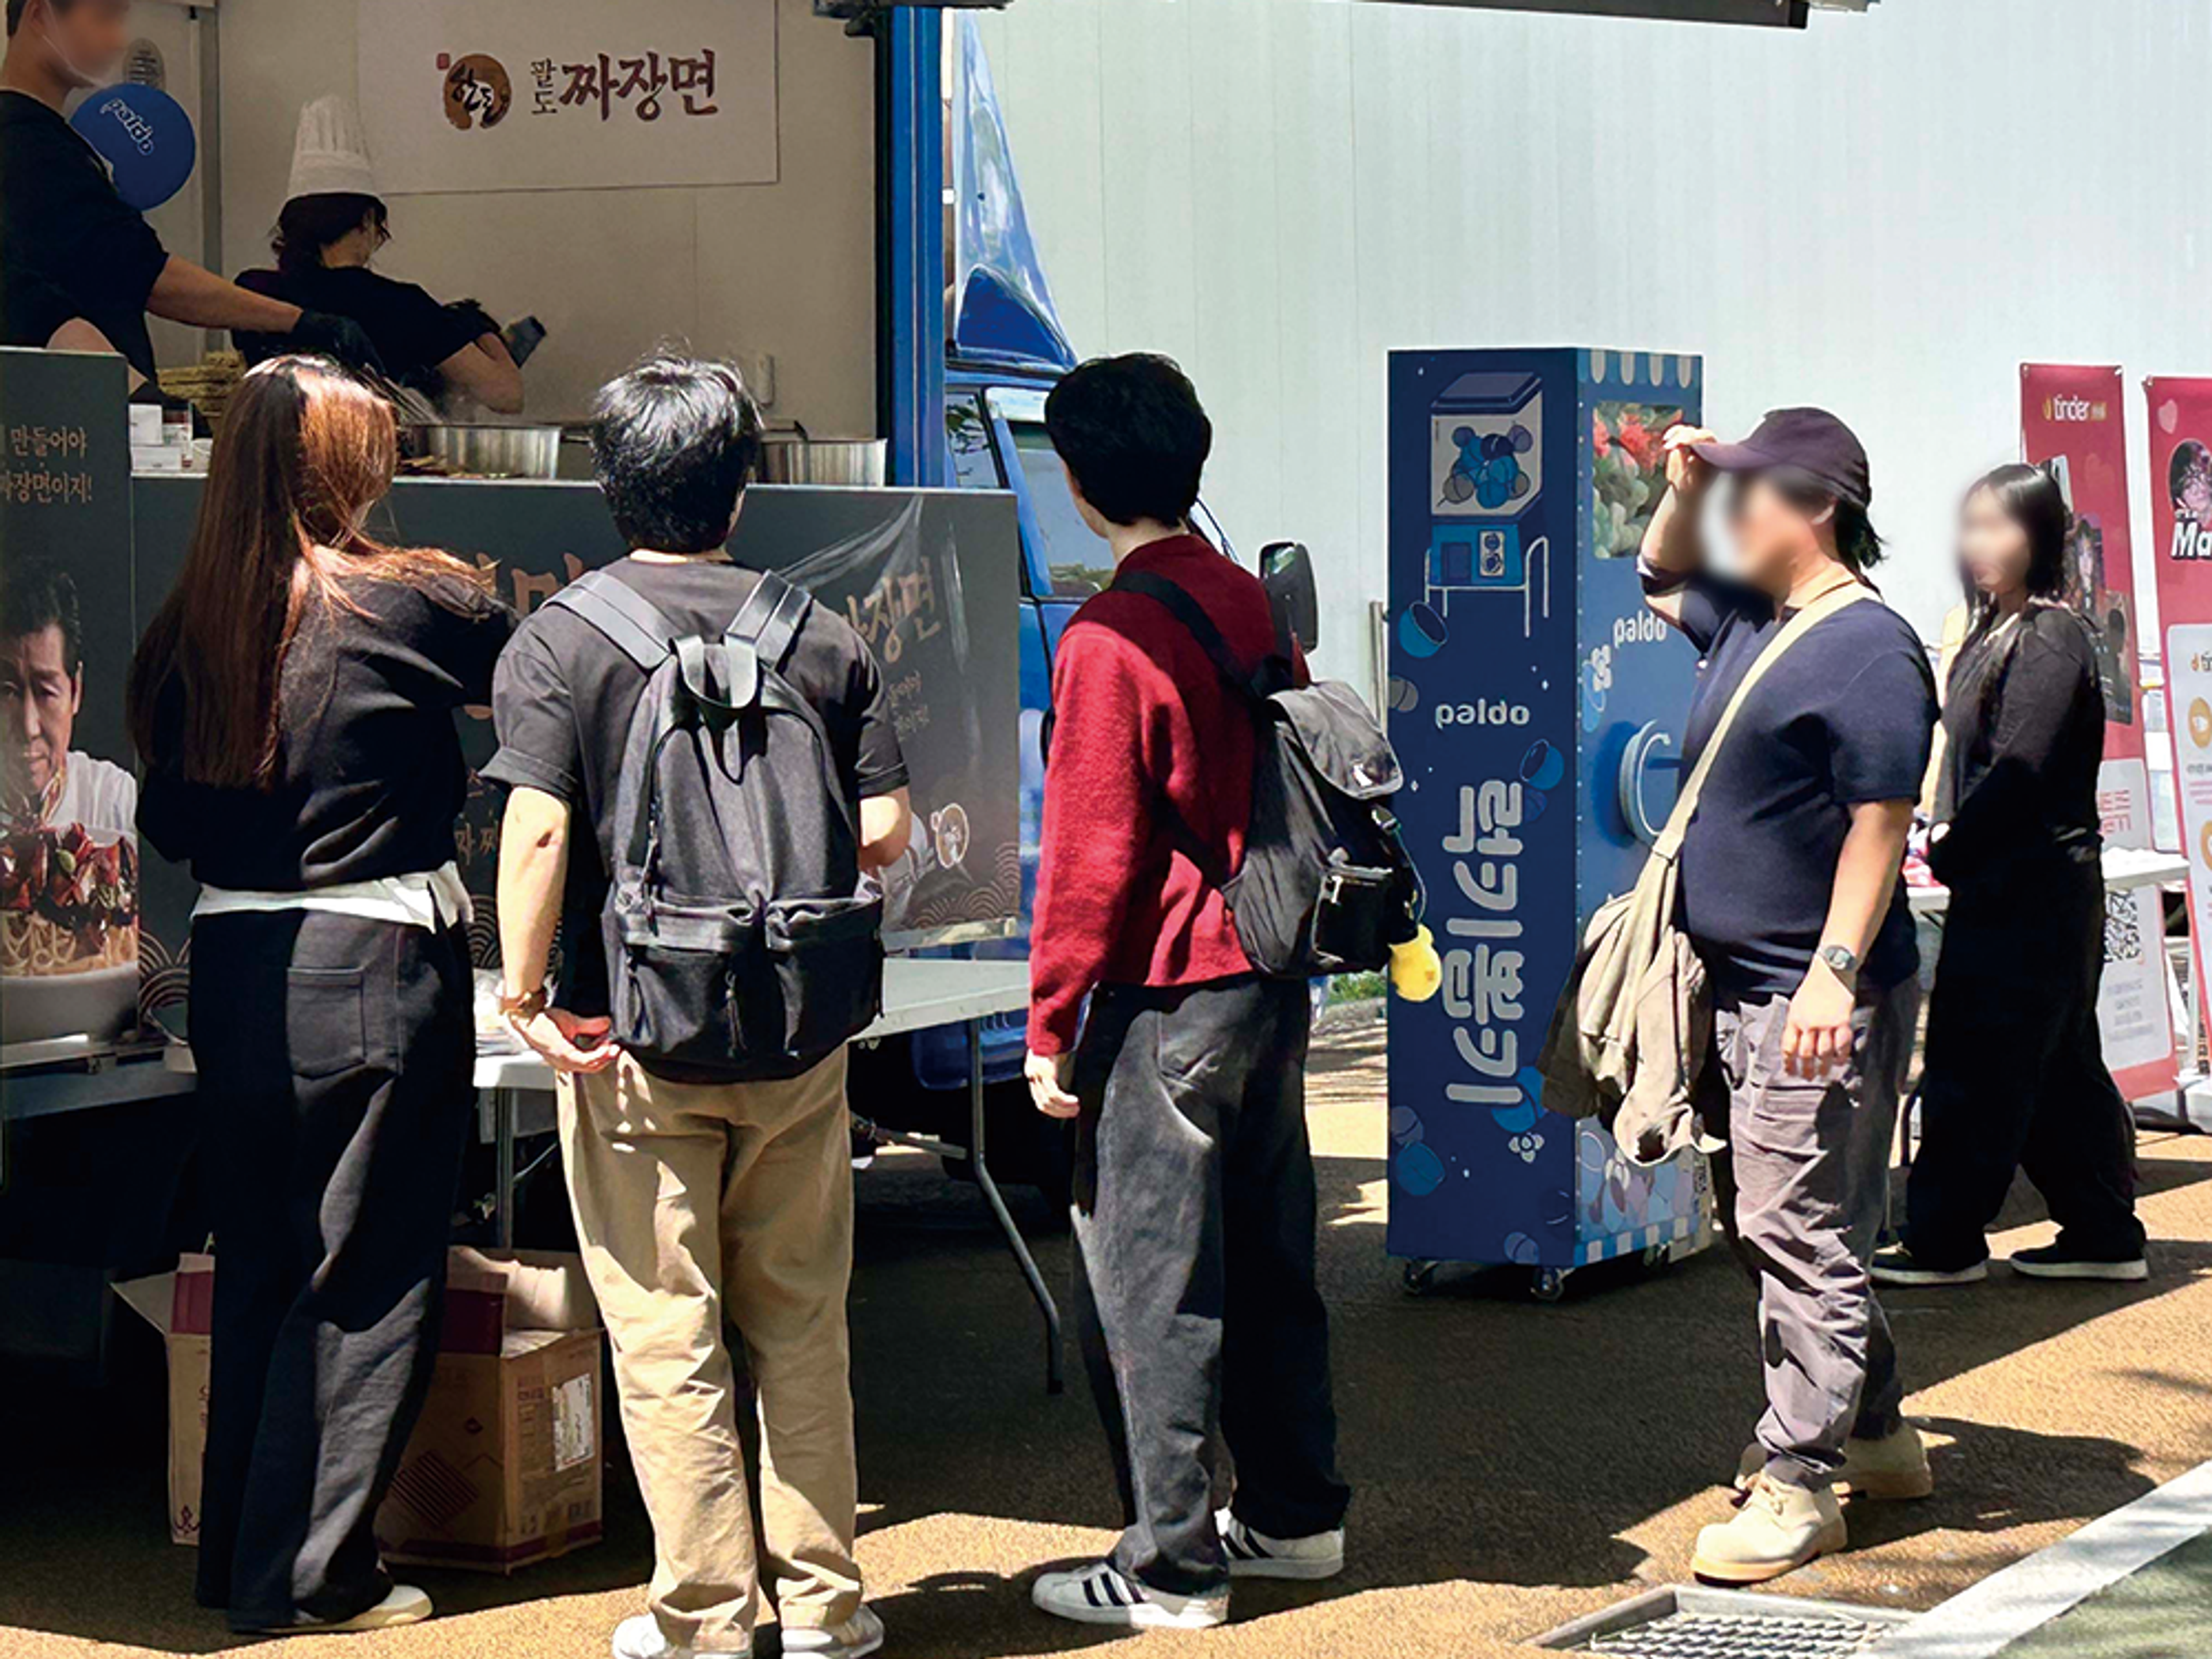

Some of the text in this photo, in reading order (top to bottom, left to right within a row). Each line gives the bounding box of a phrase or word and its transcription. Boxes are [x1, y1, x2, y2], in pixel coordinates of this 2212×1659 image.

[531, 58, 557, 115] 팔도
[559, 48, 719, 122] 짜장면
[1613, 609, 1666, 649] paldo
[1435, 698, 1530, 730] paldo
